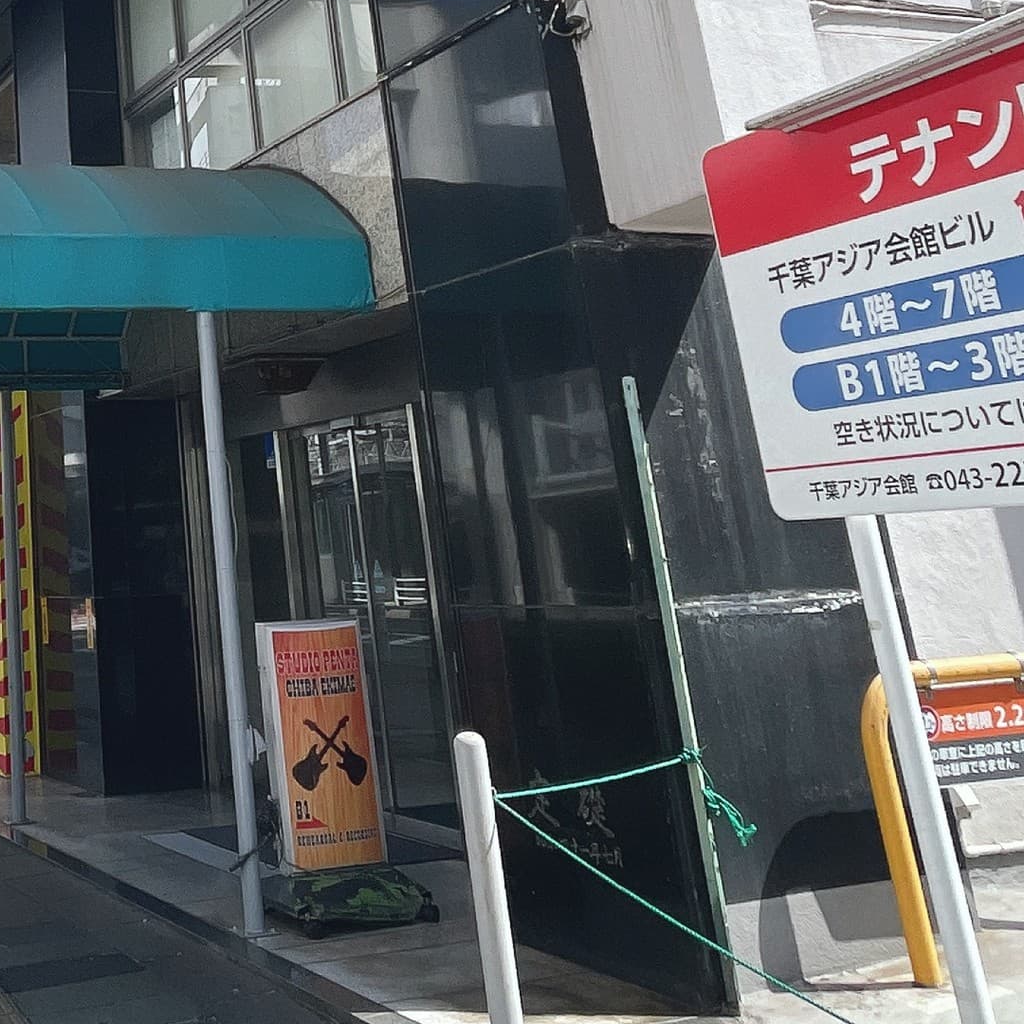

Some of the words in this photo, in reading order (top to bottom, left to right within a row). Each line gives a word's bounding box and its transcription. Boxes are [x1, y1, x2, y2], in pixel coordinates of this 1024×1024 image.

[849, 83, 1024, 203] テナン
[768, 210, 994, 295] 千葉アジア会館ビル
[808, 473, 918, 502] 千葉アジア会館
[276, 650, 320, 675] STUDIO
[286, 677, 319, 697] CHIBA
[295, 800, 310, 820] B1
